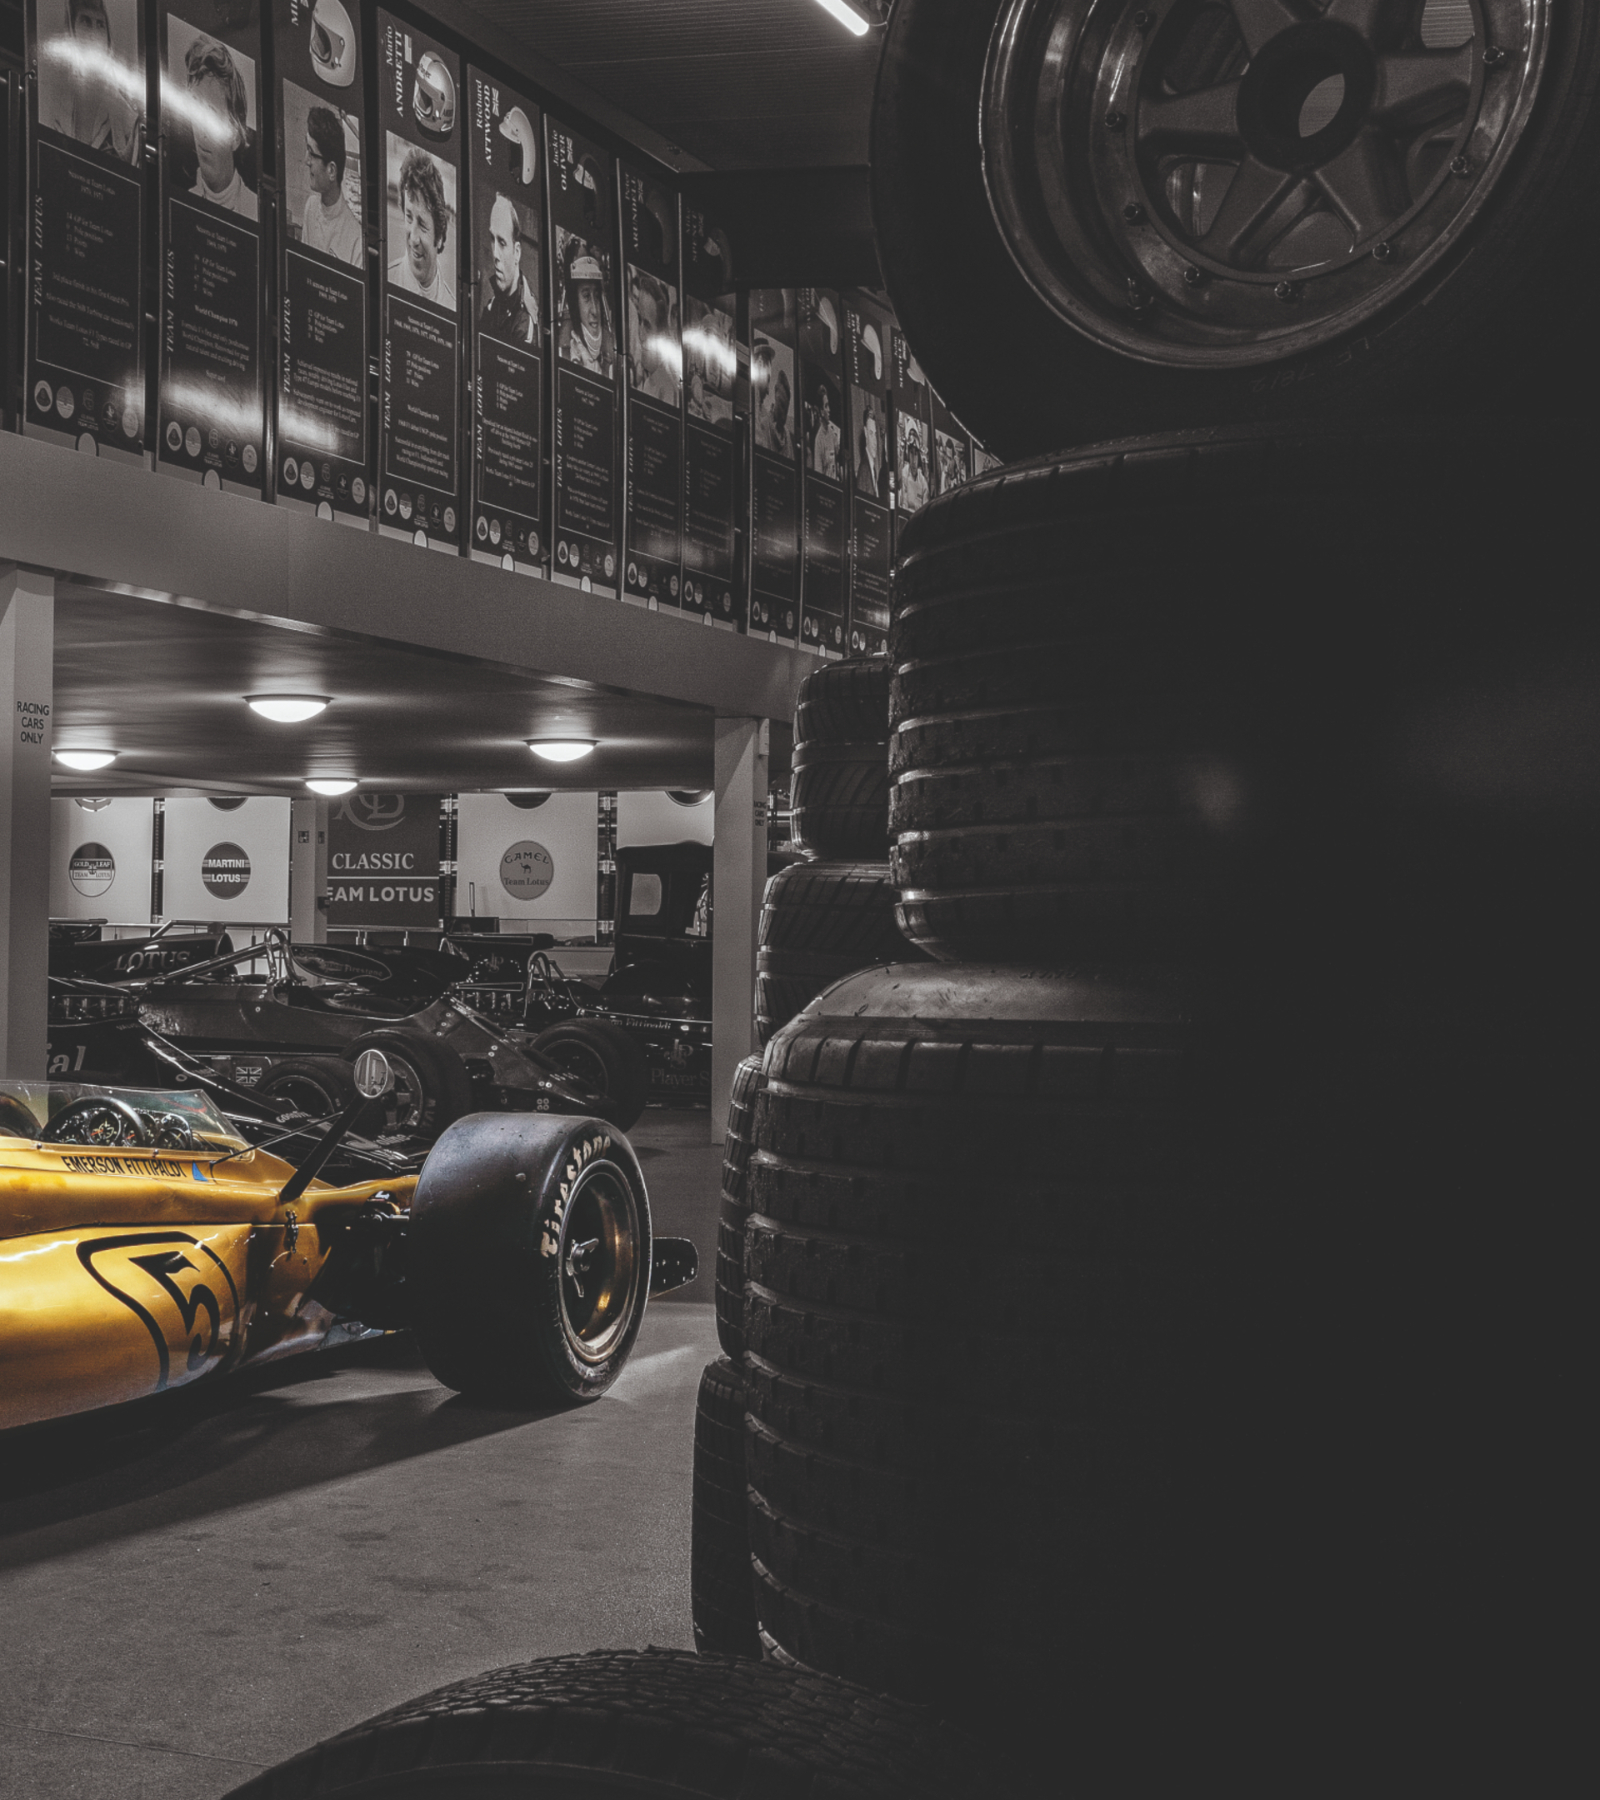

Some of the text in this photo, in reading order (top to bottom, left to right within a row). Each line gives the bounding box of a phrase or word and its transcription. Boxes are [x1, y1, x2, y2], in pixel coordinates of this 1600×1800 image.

[385, 25, 394, 66] Mario
[395, 30, 405, 118] ANDRETTI
[475, 79, 483, 129] Richard
[34, 194, 44, 306] TEAM LOTUS
[16, 701, 50, 716] RACING
[21, 716, 44, 730] CARS
[20, 731, 44, 744] ONLY
[73, 860, 111, 869] GOLD LEAF
[208, 859, 245, 869] MARTINI
[331, 852, 415, 870] CLASSIC
[504, 851, 550, 866] CAMEL
[211, 873, 241, 883] LOTUS
[504, 877, 549, 887] Team Lotus
[327, 886, 434, 902] EAM LOTUS
[114, 950, 191, 973] LOTUS
[61, 1155, 188, 1178] EMERSON FITTIPALDI
[128, 1250, 220, 1372] 5
